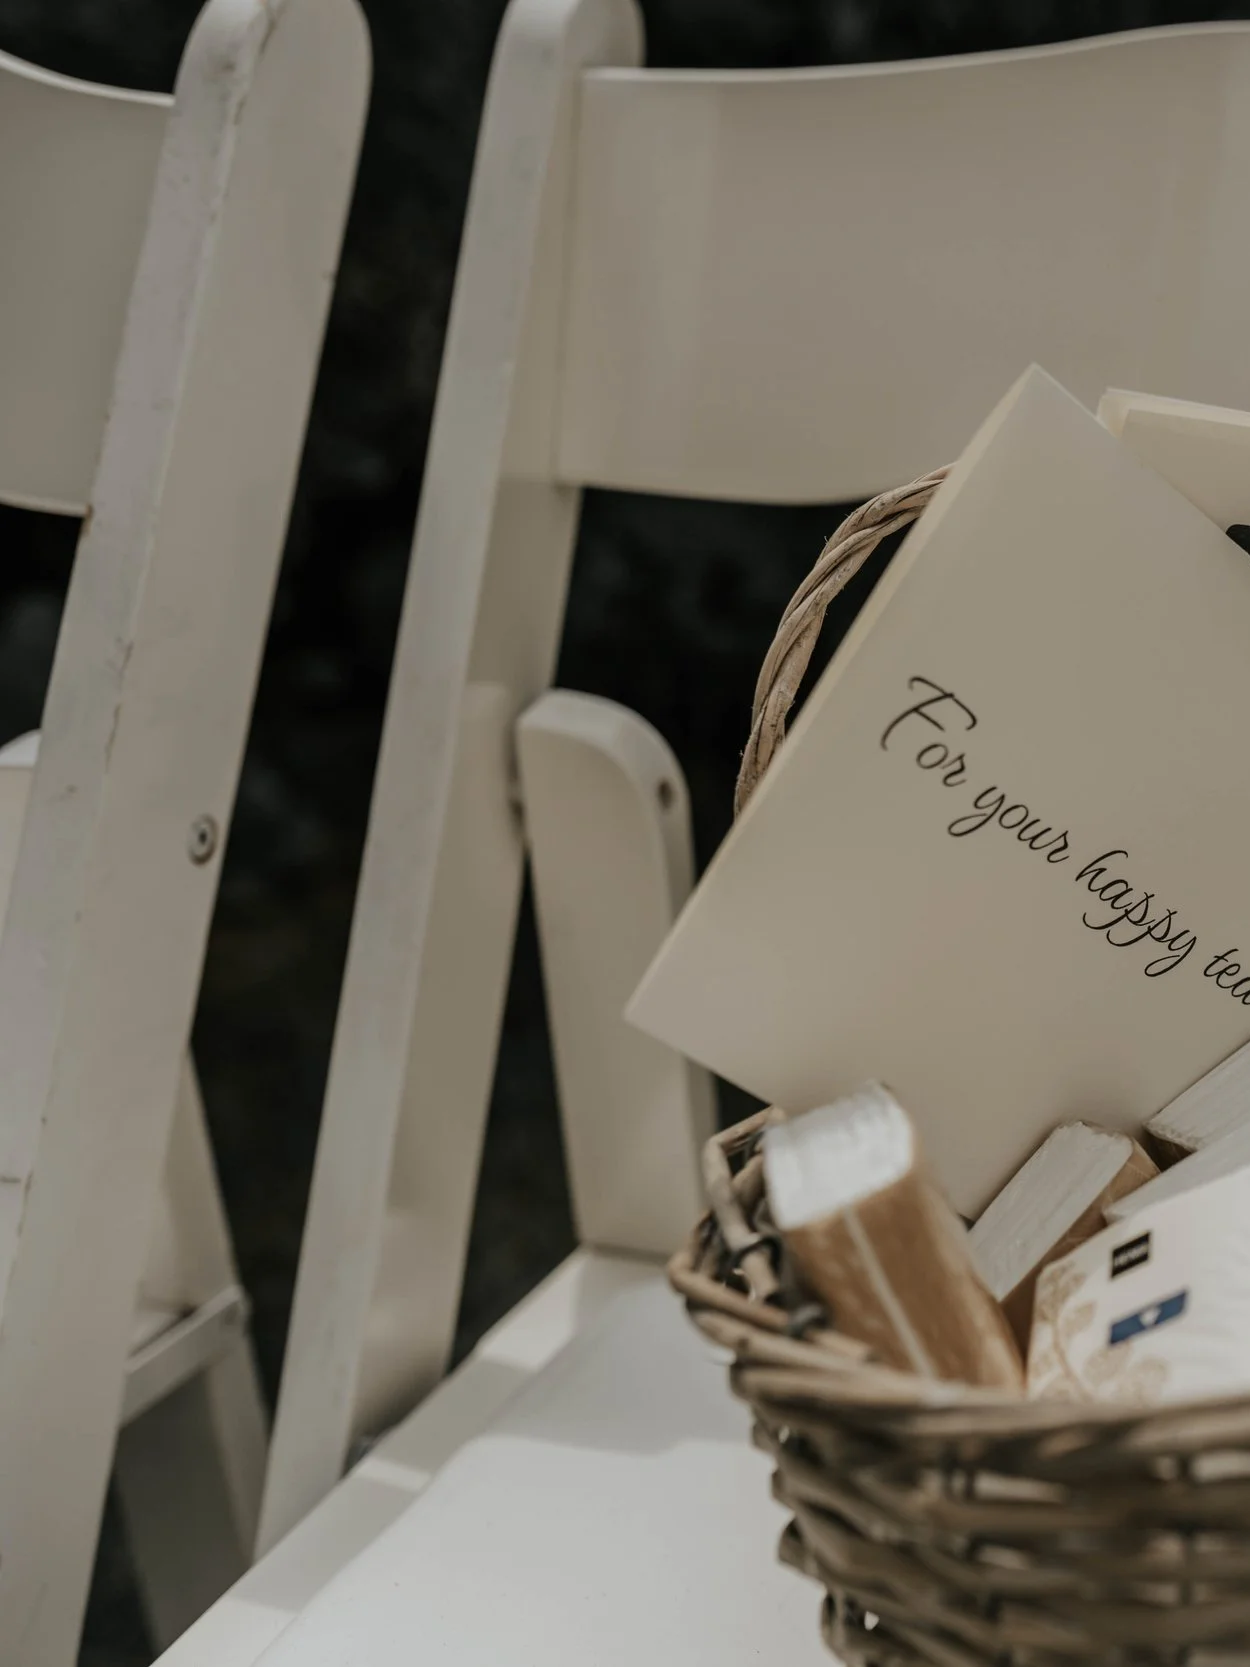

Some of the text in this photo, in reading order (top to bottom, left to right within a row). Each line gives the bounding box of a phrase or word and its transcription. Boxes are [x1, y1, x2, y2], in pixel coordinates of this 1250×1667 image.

[880, 675, 978, 788] For
[947, 786, 1070, 864] your
[1075, 849, 1197, 978] happy
